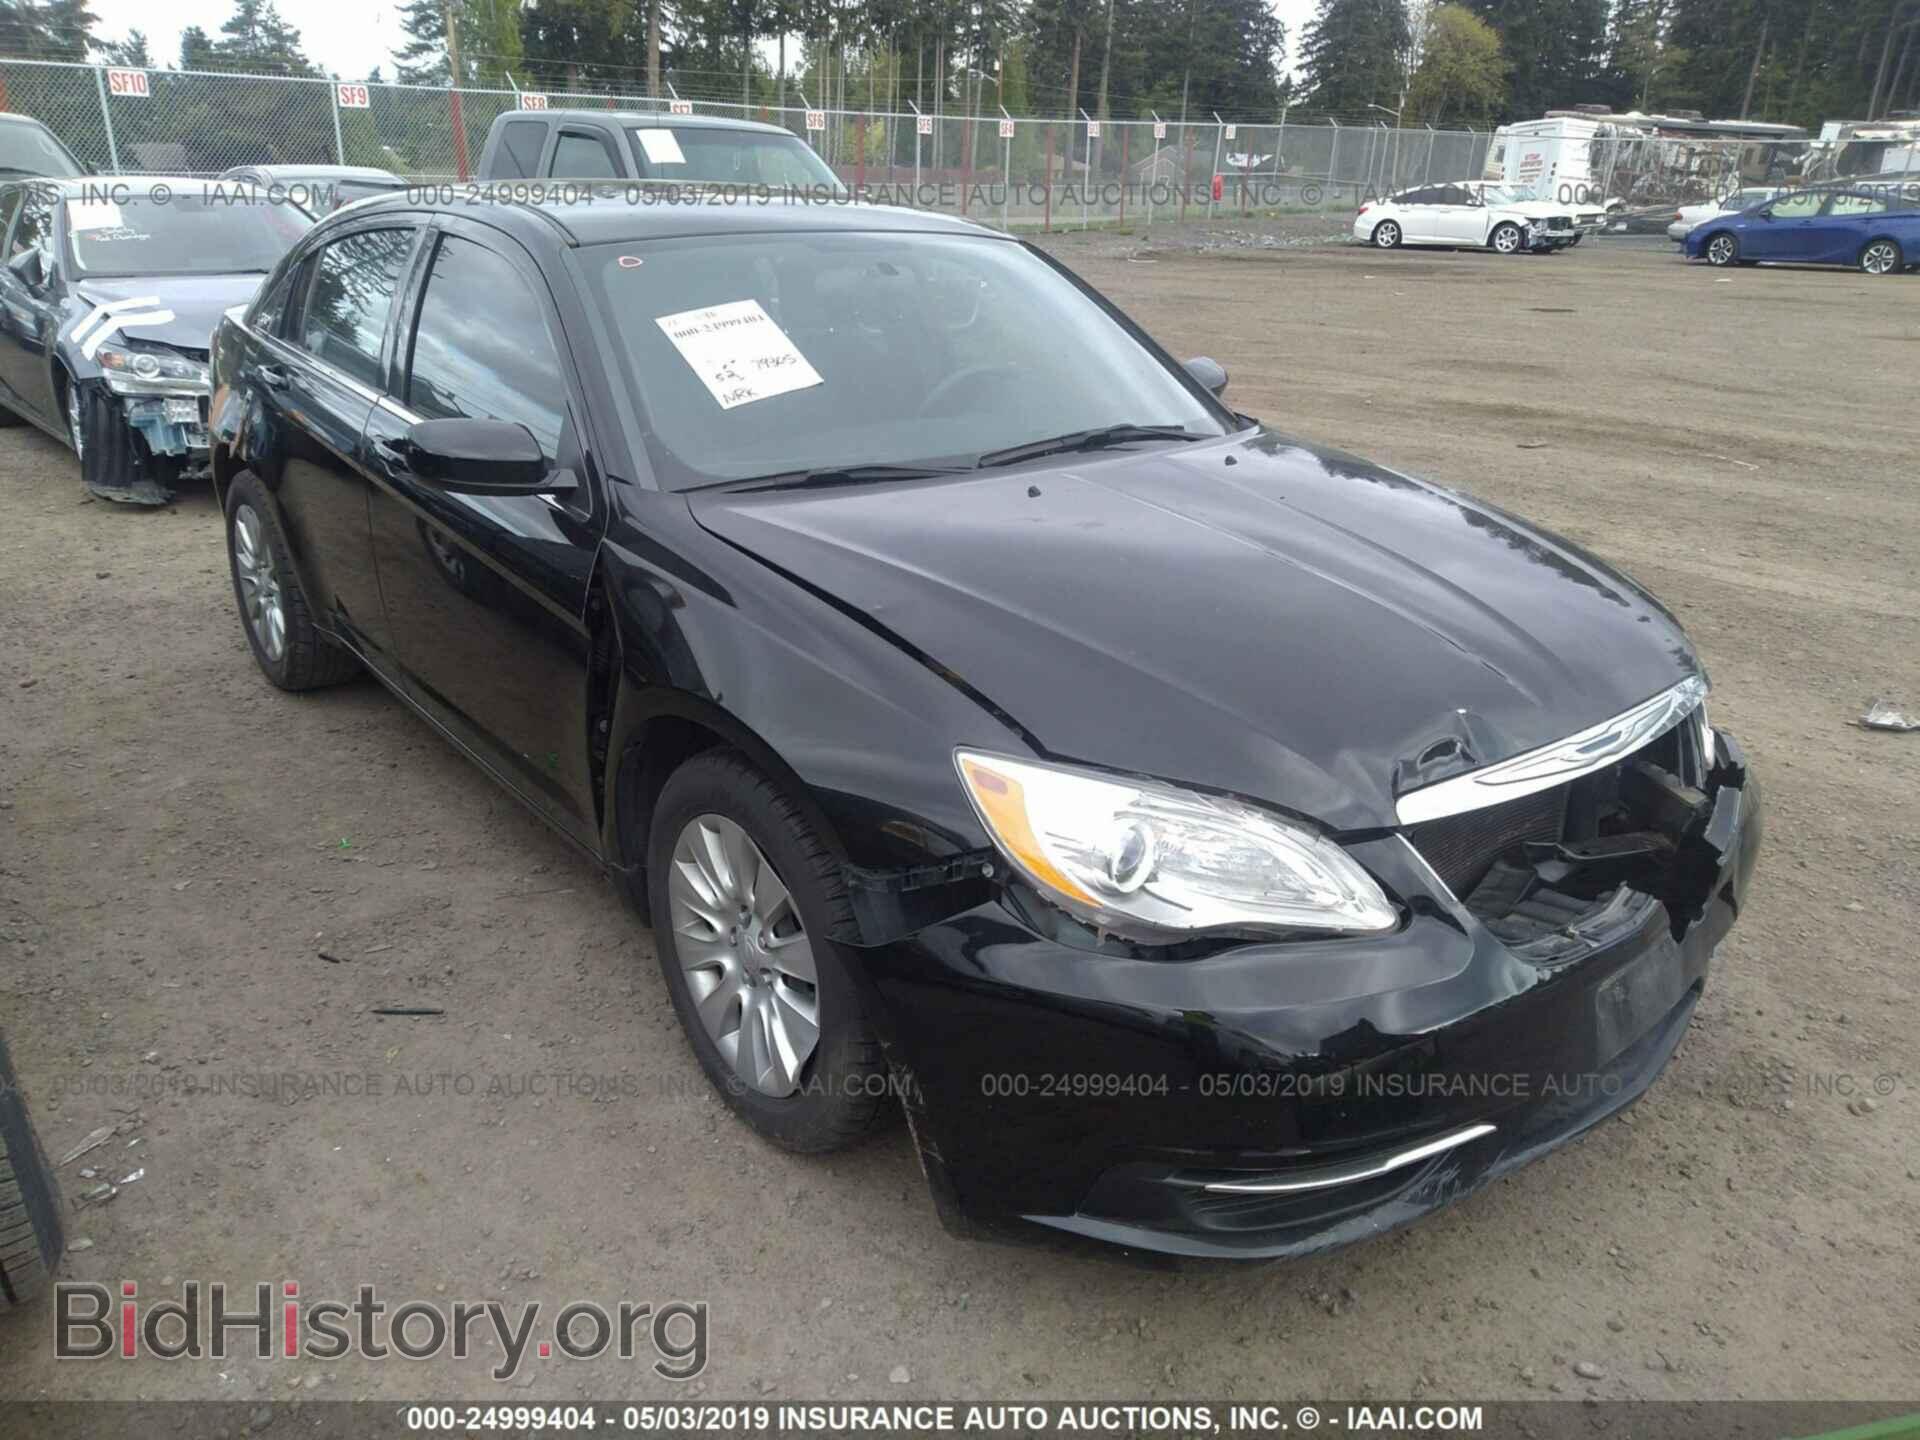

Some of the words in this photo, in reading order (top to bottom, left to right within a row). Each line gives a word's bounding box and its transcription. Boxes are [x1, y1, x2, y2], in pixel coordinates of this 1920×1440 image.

[110, 71, 146, 94] SF10
[341, 86, 367, 105] SF9
[808, 113, 824, 129] SF6
